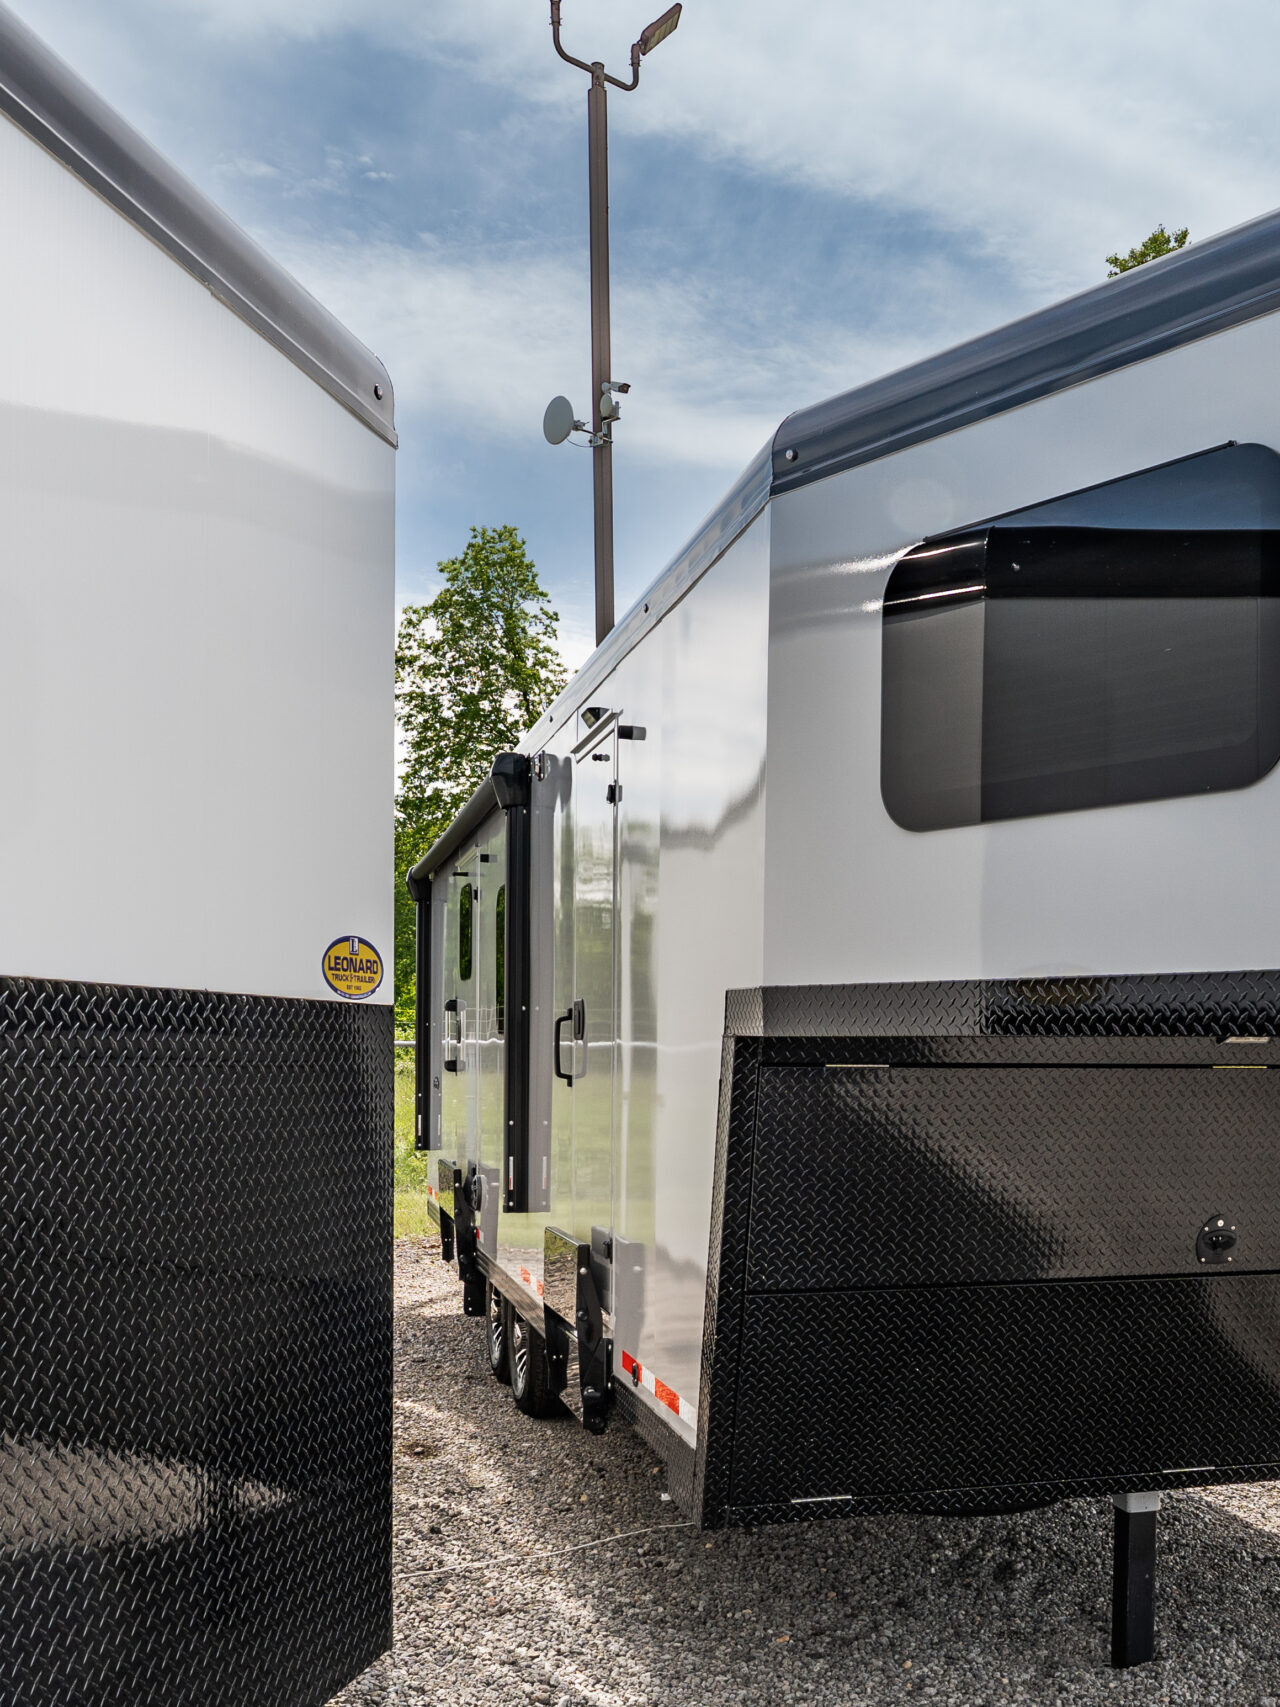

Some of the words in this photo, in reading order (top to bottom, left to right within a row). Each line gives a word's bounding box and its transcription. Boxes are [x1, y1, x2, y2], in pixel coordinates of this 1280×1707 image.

[328, 955, 379, 974] LEONARD
[331, 973, 349, 982] TRUCK
[353, 975, 376, 983] TRAILER
